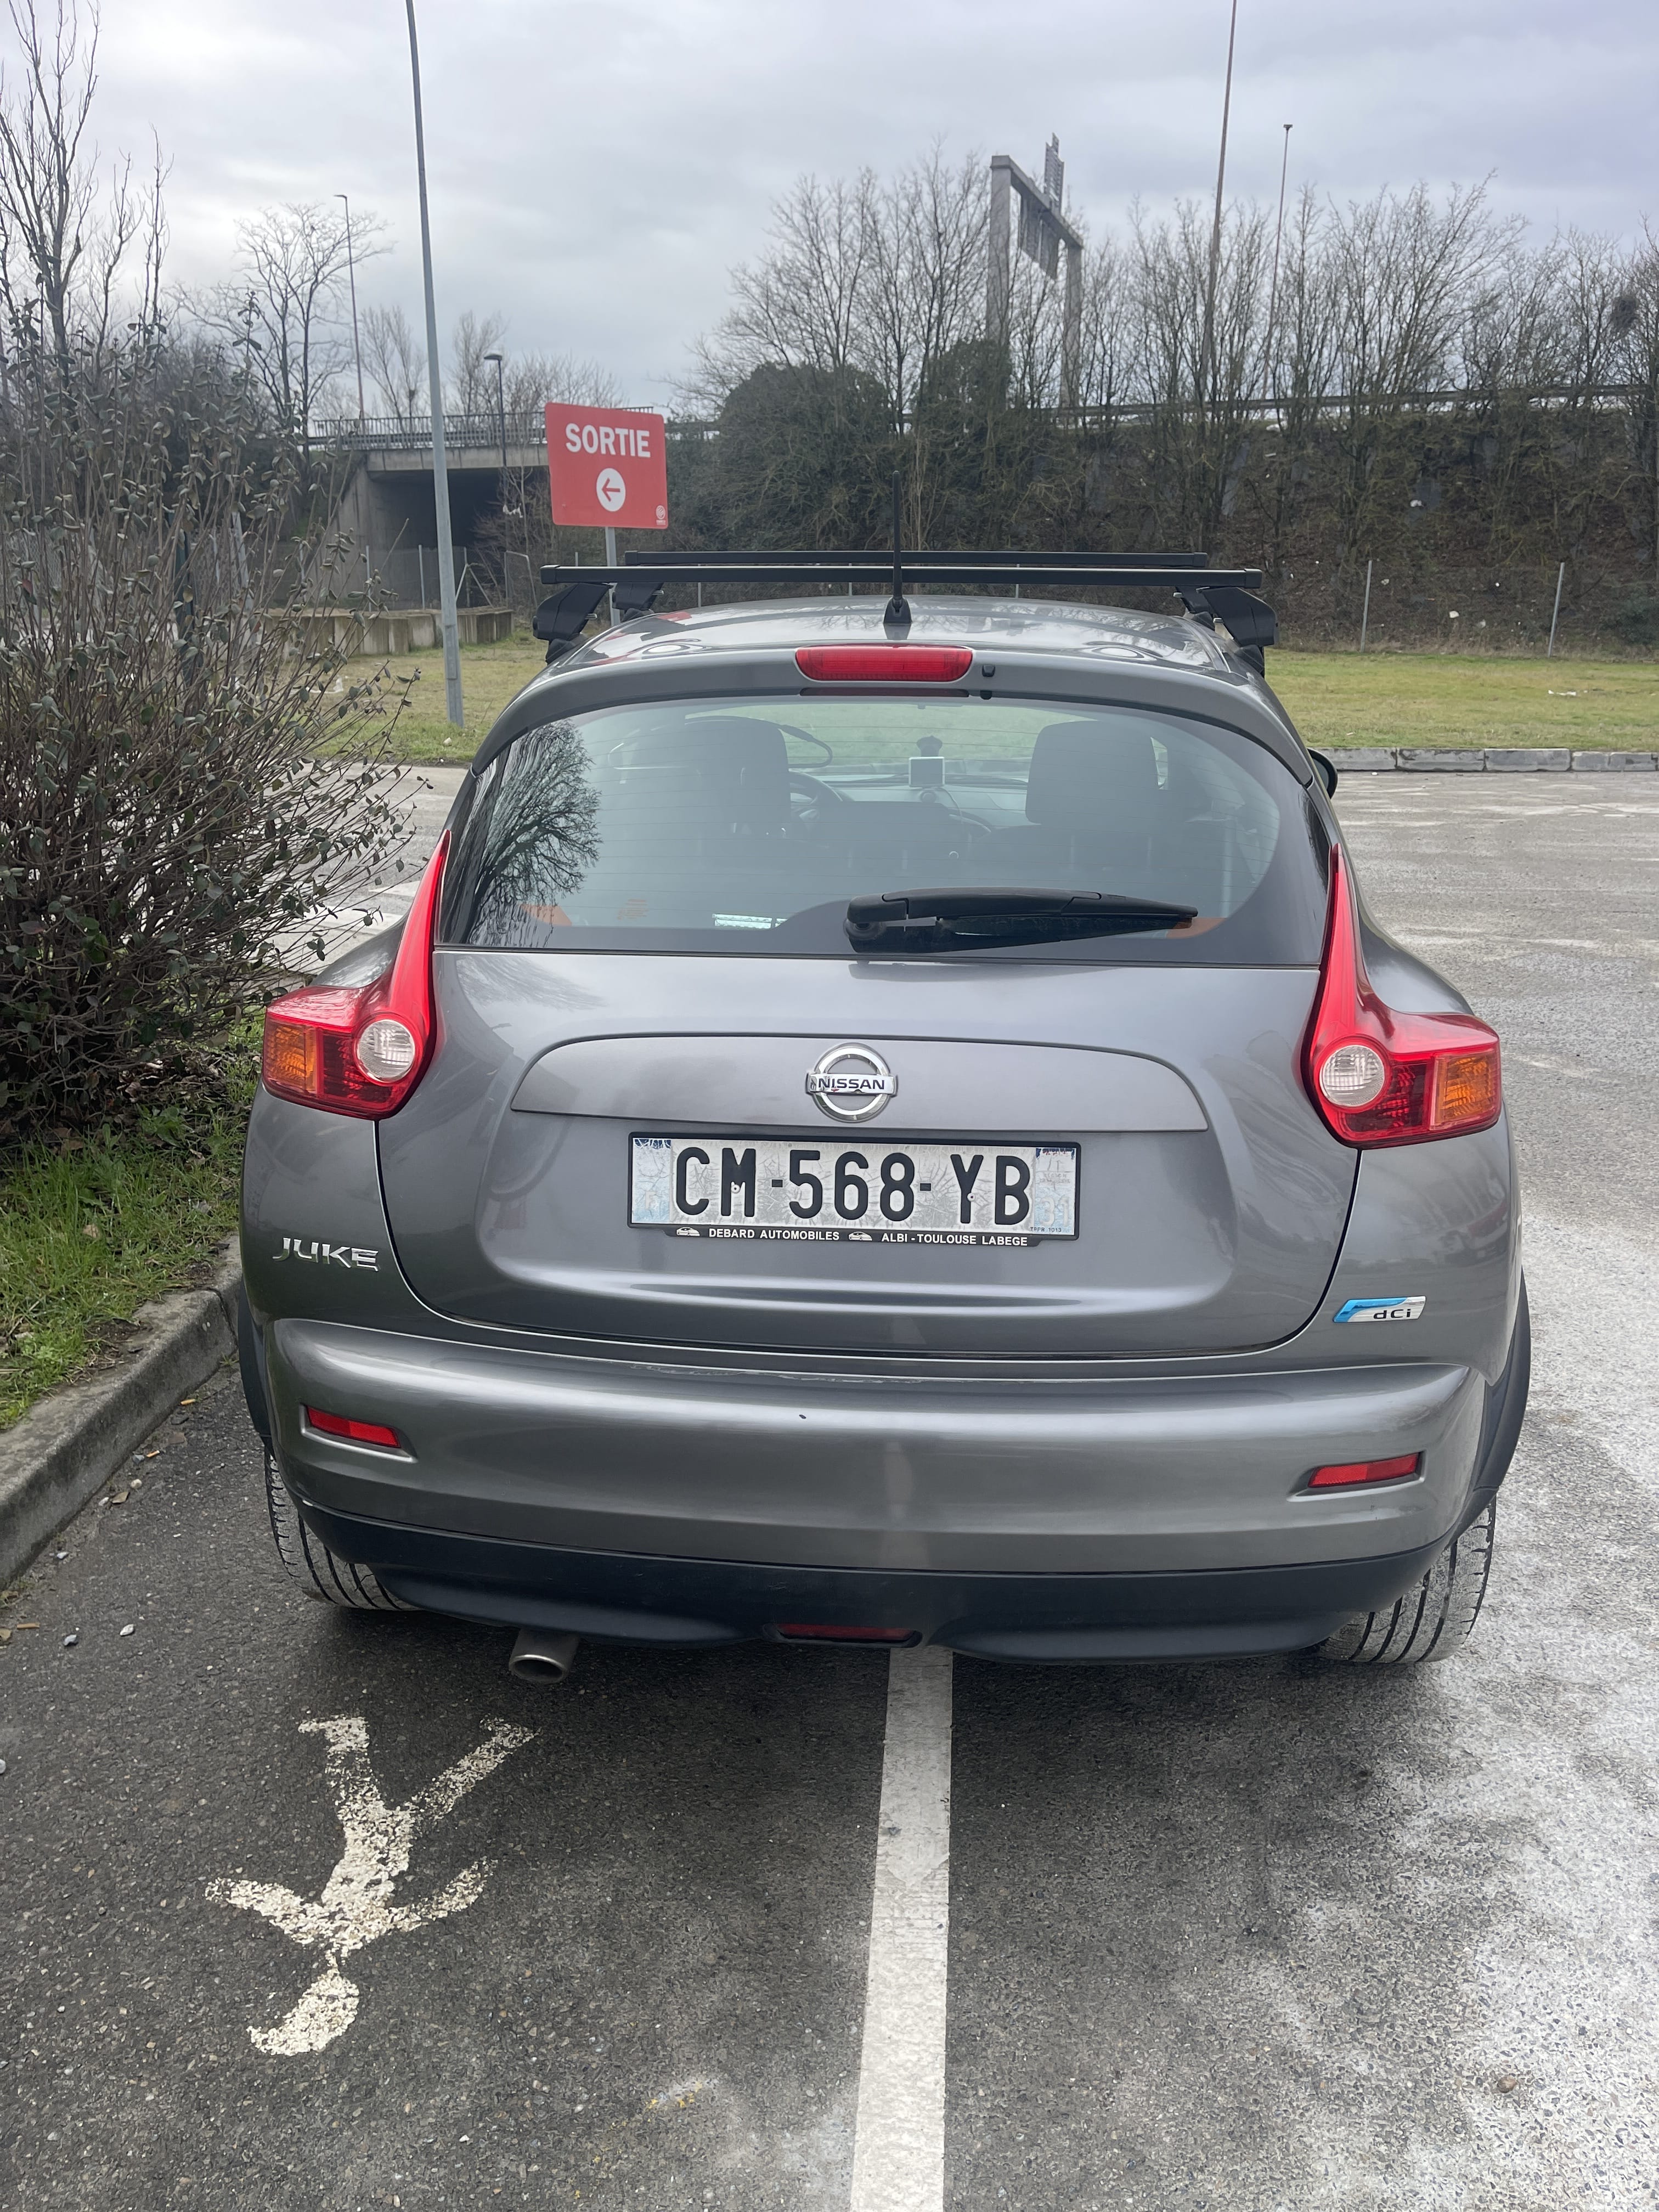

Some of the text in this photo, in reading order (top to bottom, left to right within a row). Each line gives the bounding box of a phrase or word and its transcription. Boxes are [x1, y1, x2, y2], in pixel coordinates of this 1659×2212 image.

[565, 422, 651, 458] SORTIE
[818, 1077, 885, 1090] NISSAN
[676, 1147, 1030, 1225] CM-568-YB
[1039, 1195, 1069, 1227] 31
[709, 1228, 840, 1240] DEBARD AUTOMOBILES
[881, 1232, 908, 1243] ALBI
[981, 1235, 1028, 1246] LABEGE
[272, 1237, 380, 1272] JUKE
